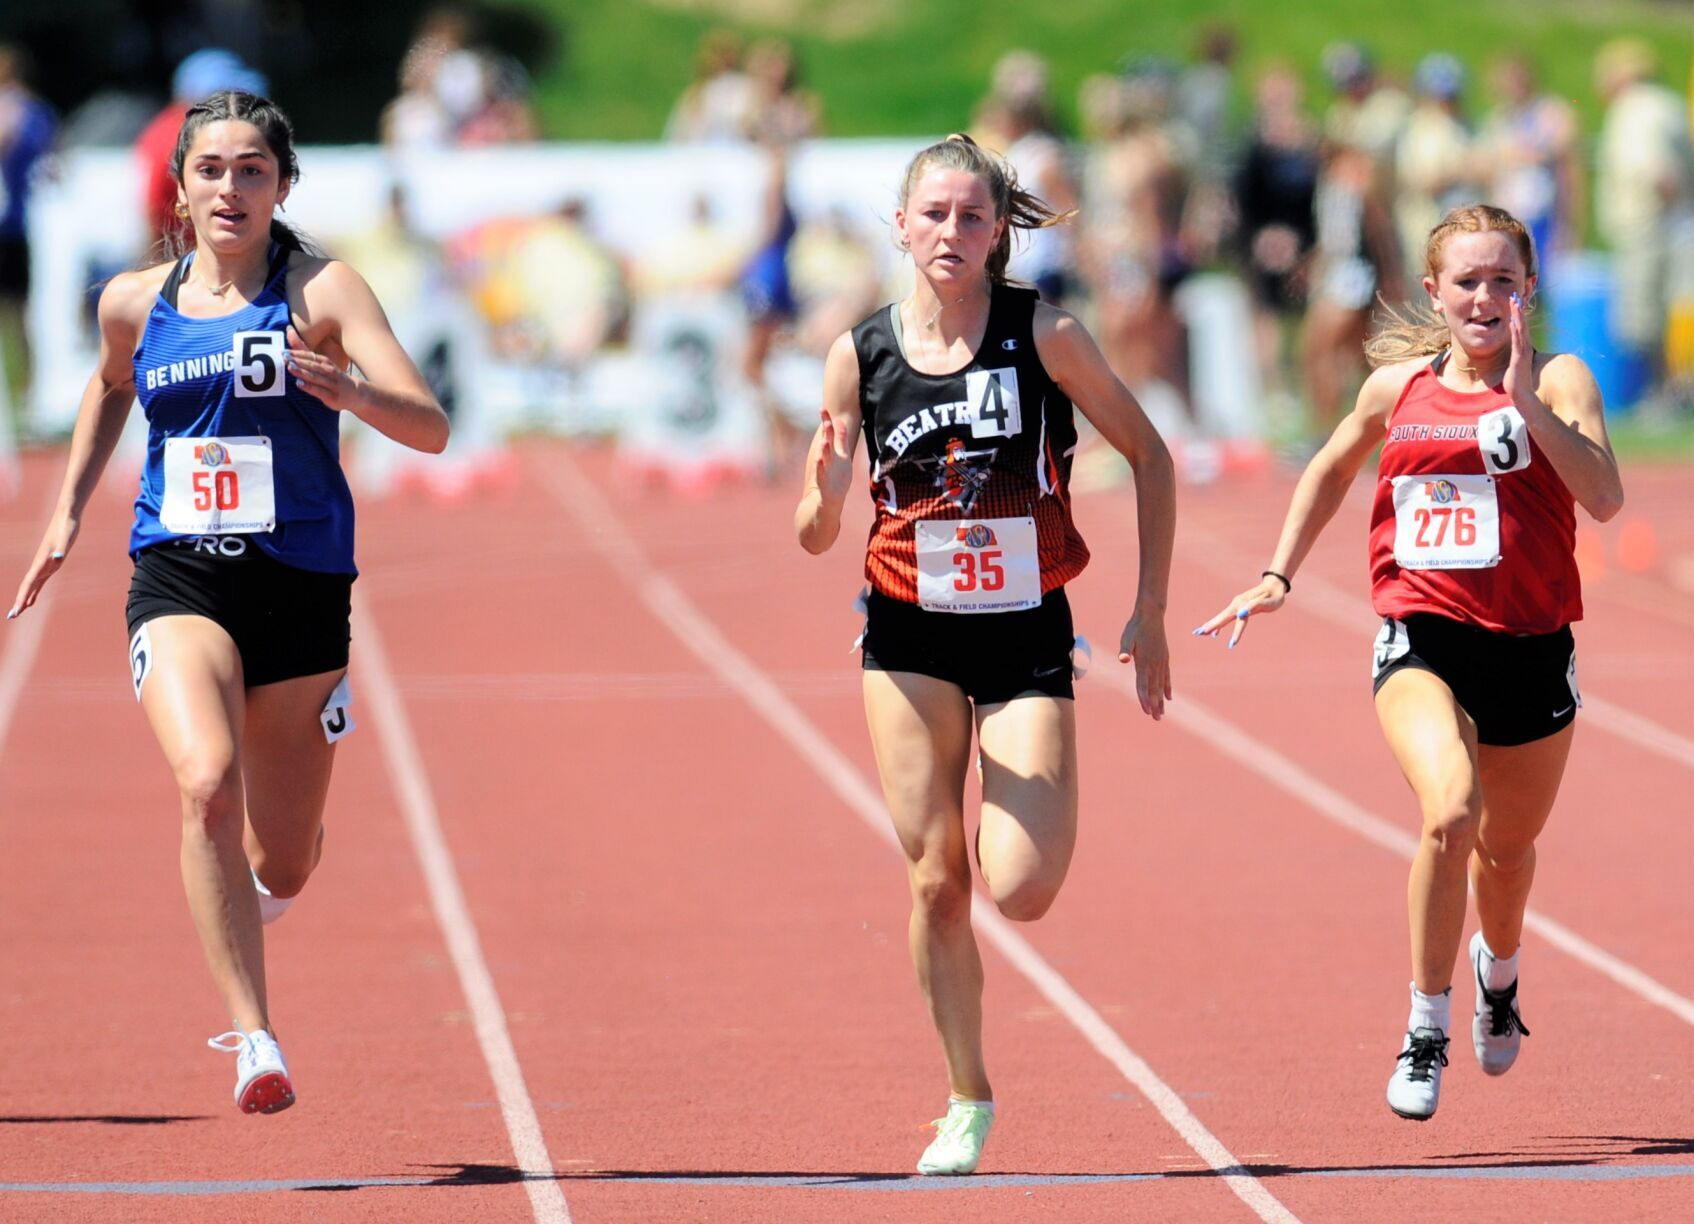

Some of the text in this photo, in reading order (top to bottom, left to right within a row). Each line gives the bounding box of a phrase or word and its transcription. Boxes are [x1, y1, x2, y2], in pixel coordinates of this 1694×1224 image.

[241, 336, 276, 392] 5
[979, 372, 1009, 431] 4
[1433, 424, 1479, 441] SIOUX
[1488, 413, 1518, 470] 3
[192, 470, 239, 511] 50
[1414, 507, 1476, 547] 276
[953, 550, 1004, 592] 35
[932, 602, 951, 610] TRACK
[978, 600, 1029, 609] CHAMPIONSHIPS
